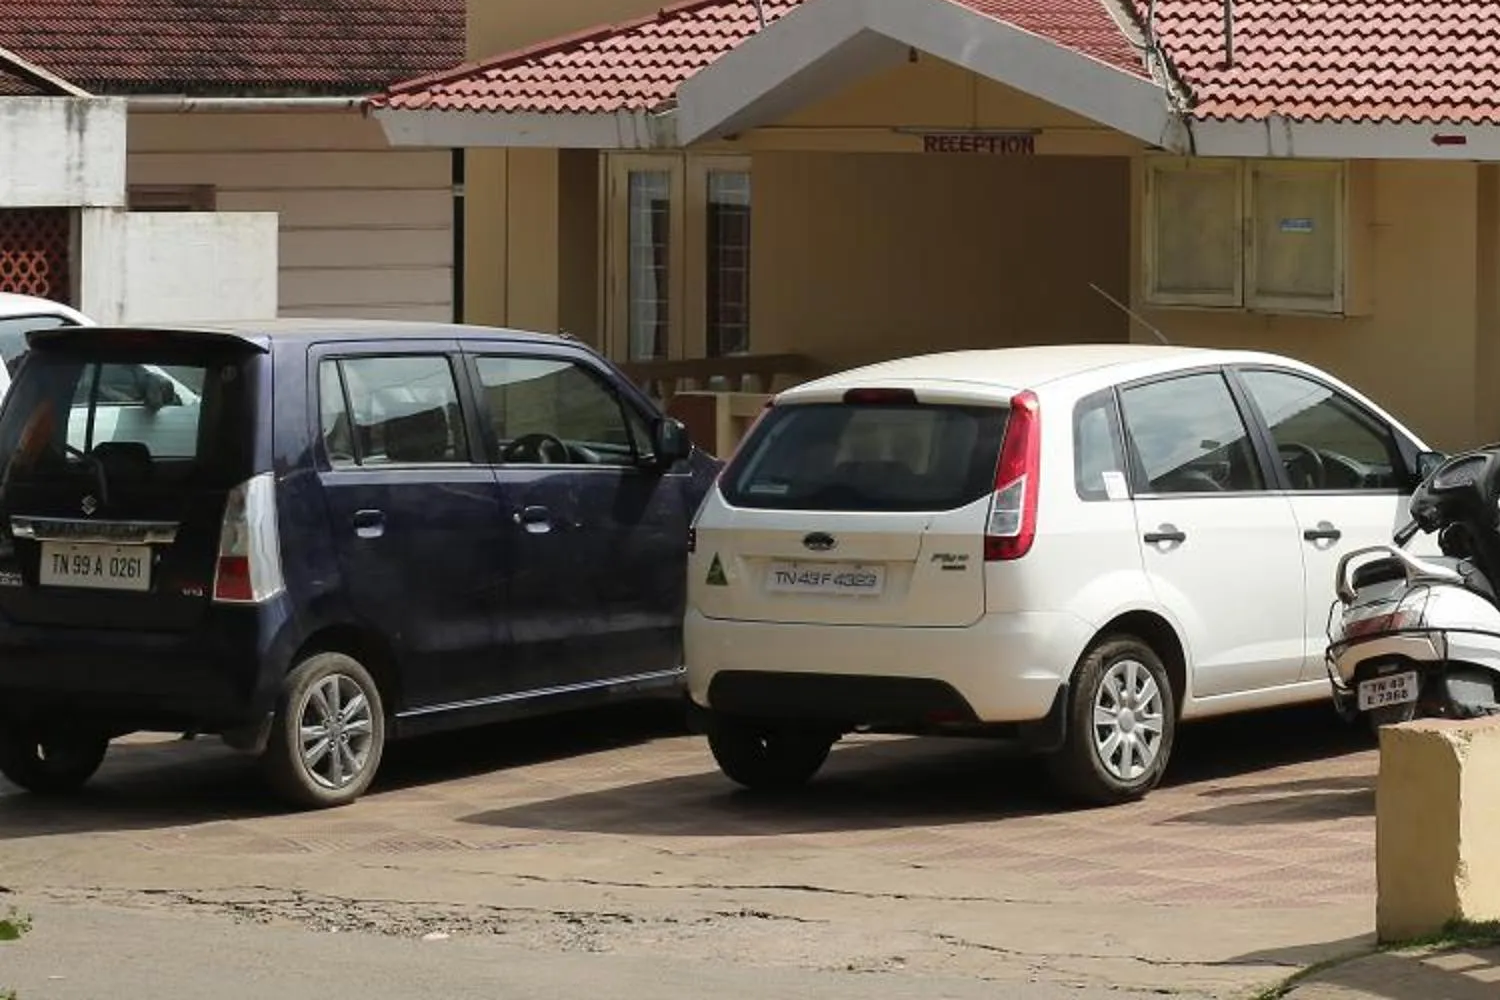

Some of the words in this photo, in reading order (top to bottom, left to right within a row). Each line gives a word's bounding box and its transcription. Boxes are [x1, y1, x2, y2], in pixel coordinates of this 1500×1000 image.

[923, 135, 1036, 155] RECEPTION
[53, 554, 69, 574] TN
[73, 555, 90, 575] 99
[95, 558, 103, 577] A
[109, 558, 141, 578] 0261
[775, 571, 797, 585] TN
